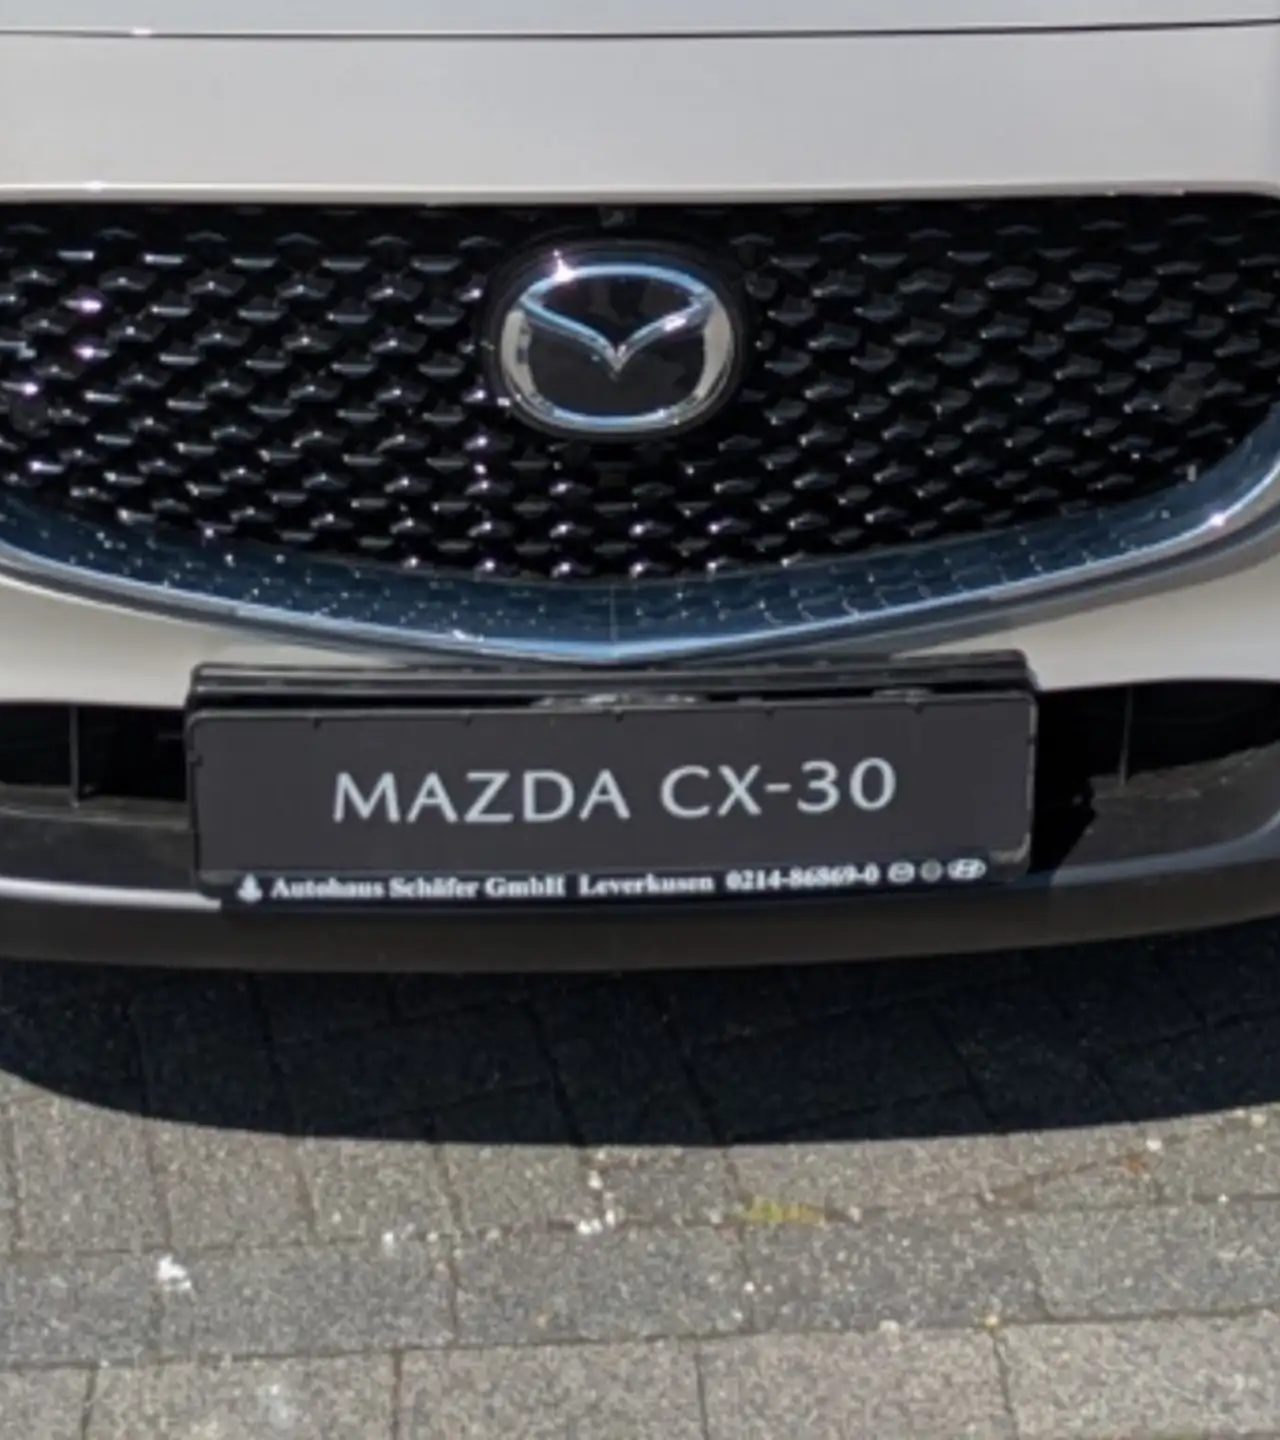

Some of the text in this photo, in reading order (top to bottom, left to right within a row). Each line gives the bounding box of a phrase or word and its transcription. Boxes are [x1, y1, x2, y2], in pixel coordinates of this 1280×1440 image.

[332, 757, 897, 823] MAZDA CX-30
[271, 876, 385, 899] Autohaus
[388, 875, 480, 898] Schäfer
[484, 874, 568, 898] GmbH
[578, 872, 716, 897] Leverkusen
